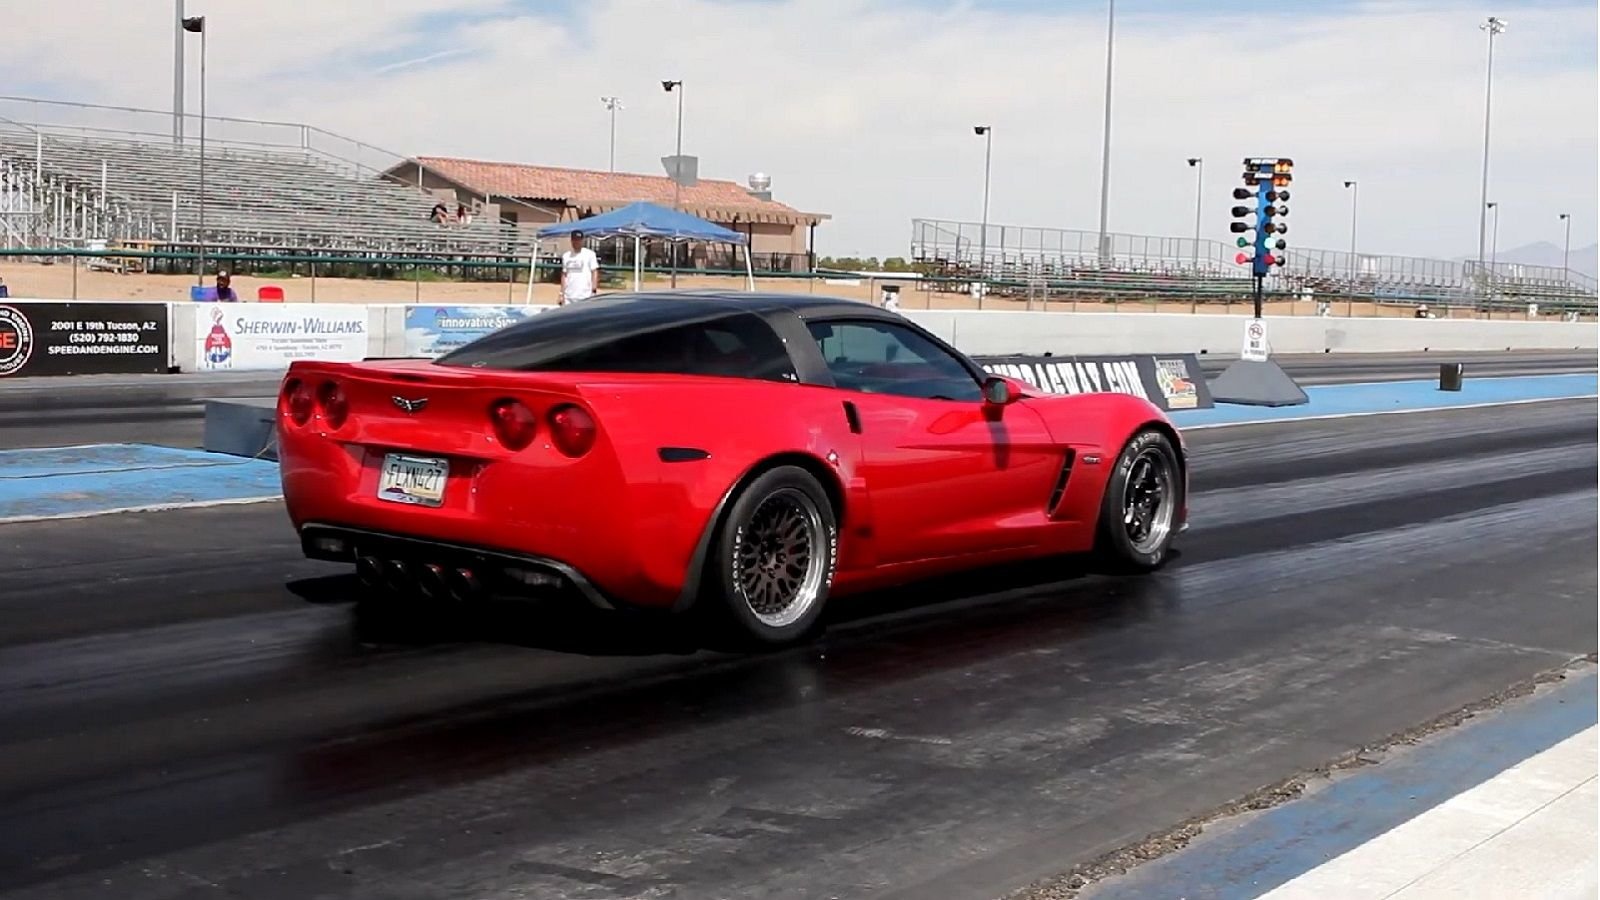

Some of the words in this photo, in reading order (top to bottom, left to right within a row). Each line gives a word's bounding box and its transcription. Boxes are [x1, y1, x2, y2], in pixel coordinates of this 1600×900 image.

[51, 321, 74, 330] 2001
[77, 321, 83, 330] E
[85, 321, 105, 330] 19th
[107, 321, 141, 331] Tucson,
[143, 321, 157, 330] AZ
[235, 317, 362, 335] SHERWIN-WILLIAMS
[0, 332, 17, 349] E
[69, 333, 96, 343] (520)
[48, 346, 159, 354] SPEEDANDENGINE.COM
